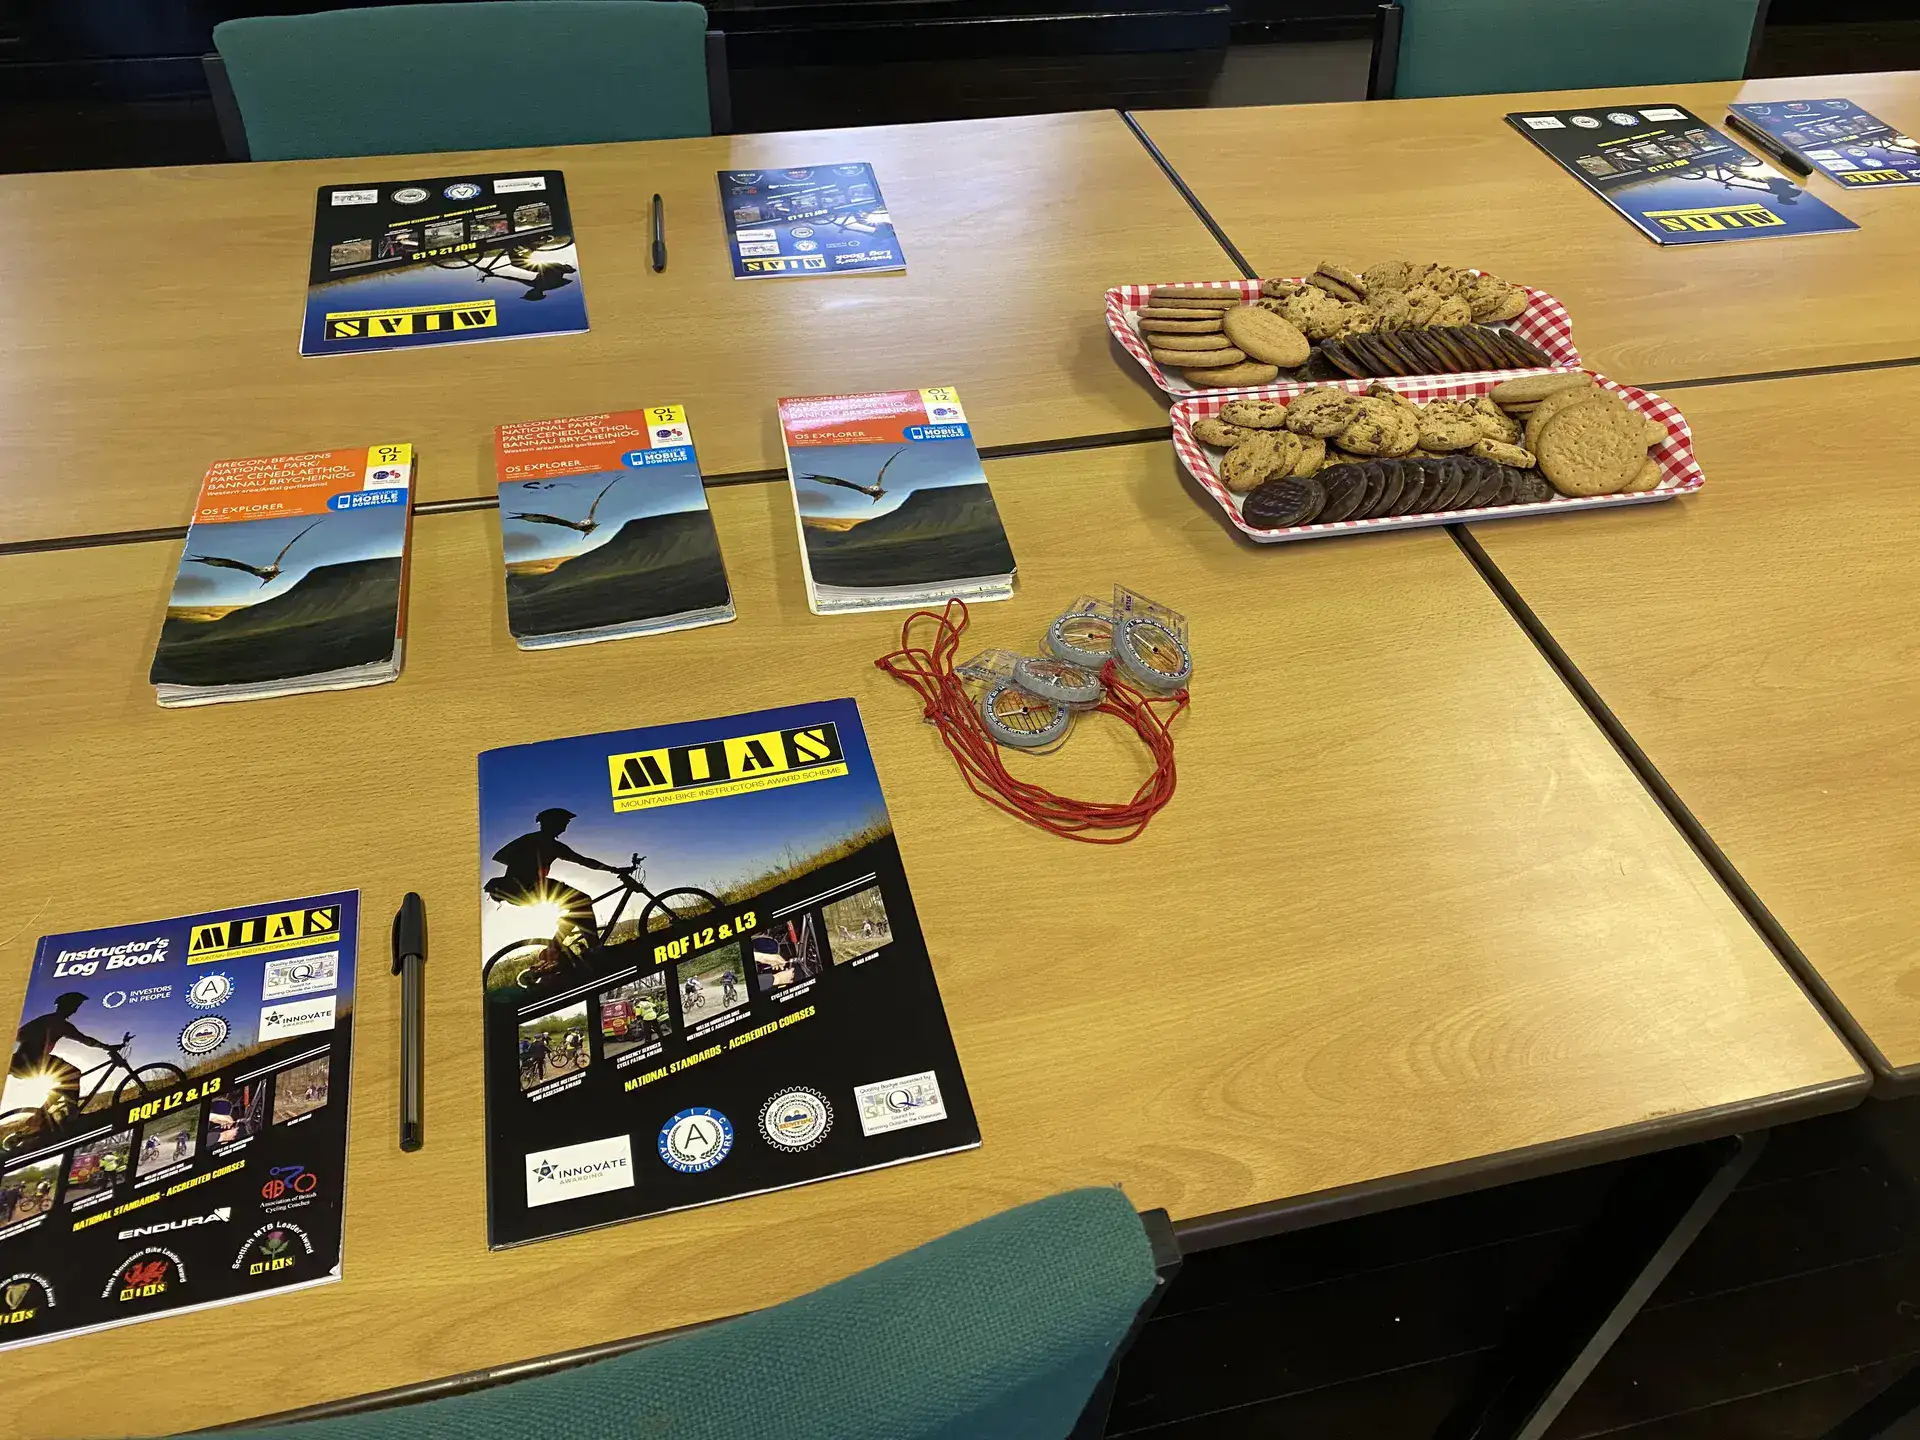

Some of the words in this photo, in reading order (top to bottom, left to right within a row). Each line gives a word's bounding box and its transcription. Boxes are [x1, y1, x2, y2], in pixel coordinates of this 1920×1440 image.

[1655, 209, 1780, 232] MIAS
[745, 257, 825, 272] MIAS
[331, 306, 494, 339] MIAS
[502, 420, 551, 430] BRECON
[554, 414, 610, 424] BEACONS
[658, 414, 674, 422] 12
[502, 426, 565, 436] NATIONAL
[568, 421, 602, 429] PARK/
[502, 434, 534, 442] PARC
[536, 425, 632, 438] CENEDLAETHOL
[812, 431, 866, 439] EXPLORER
[502, 439, 556, 449] BANNAU
[559, 430, 640, 444] BRYCHEINIOG
[378, 446, 402, 454] OL
[382, 454, 398, 462] 12
[644, 451, 687, 460] MOBILE
[212, 465, 280, 476] NATIONAL
[284, 460, 320, 469] PARK/
[214, 459, 267, 469] BRECON
[271, 453, 332, 464] BEACONS
[505, 466, 520, 474] OS
[524, 460, 582, 471] EXPLORER
[208, 480, 266, 490] BANNAU
[269, 472, 356, 486] BRYCHEINIOG
[210, 474, 244, 484] PARC
[247, 466, 350, 480] CENEDLAETHOL
[352, 494, 398, 503] MOBILE
[352, 500, 398, 508] DOWNLOAD
[201, 508, 218, 516] OS
[222, 503, 284, 514] EXPLORER
[613, 726, 837, 793] MIAS
[620, 792, 696, 808] MOUNTAIN-BIKE
[698, 780, 765, 796] INSTRUCTORS
[766, 774, 801, 786] AWARD
[802, 766, 842, 780] SCHEME
[190, 907, 335, 952] MIAS
[654, 936, 690, 964] RQF
[692, 927, 715, 950] L2
[718, 924, 734, 940] &
[734, 912, 757, 934] L3
[56, 937, 170, 964] Instructor's
[53, 961, 100, 978] Log
[106, 949, 168, 970] Book
[130, 984, 172, 996] INVESTORS
[201, 980, 218, 996] A
[128, 996, 139, 1004] IN
[140, 992, 171, 1002] PEOPLE
[282, 1010, 332, 1024] INNOVATE
[624, 1066, 669, 1092] NATIONAL
[670, 1044, 722, 1074] STANDARDS
[728, 1022, 778, 1050] ACCREDITED
[779, 1005, 816, 1029] COURSES
[860, 1086, 880, 1094] Quality
[128, 1098, 162, 1124] RQF
[164, 1092, 184, 1110] L2
[186, 1088, 199, 1102] &
[202, 1078, 221, 1096] L3
[684, 1124, 708, 1150] A
[660, 1134, 732, 1172] ADVENTUREMARK
[559, 1158, 627, 1178] INNOVATE
[560, 1172, 604, 1185] AWARDING
[72, 1212, 112, 1232] NATIONAL
[114, 1192, 160, 1217] STANDARDS
[166, 1172, 211, 1197] ACCREDITED
[212, 1160, 246, 1180] COURSES
[260, 1198, 290, 1208] Association
[118, 1211, 222, 1240] ENDURA
[232, 1238, 254, 1270] Scottish
[254, 1223, 274, 1238] MTB
[276, 1221, 302, 1234] Leader
[300, 1232, 314, 1254] Award
[101, 1277, 116, 1298] Welsh
[112, 1250, 144, 1277] Mountain
[162, 1248, 180, 1264] Leader
[176, 1263, 187, 1283] Award
[250, 1257, 293, 1275] MIAS
[120, 1284, 165, 1301] MIAS
